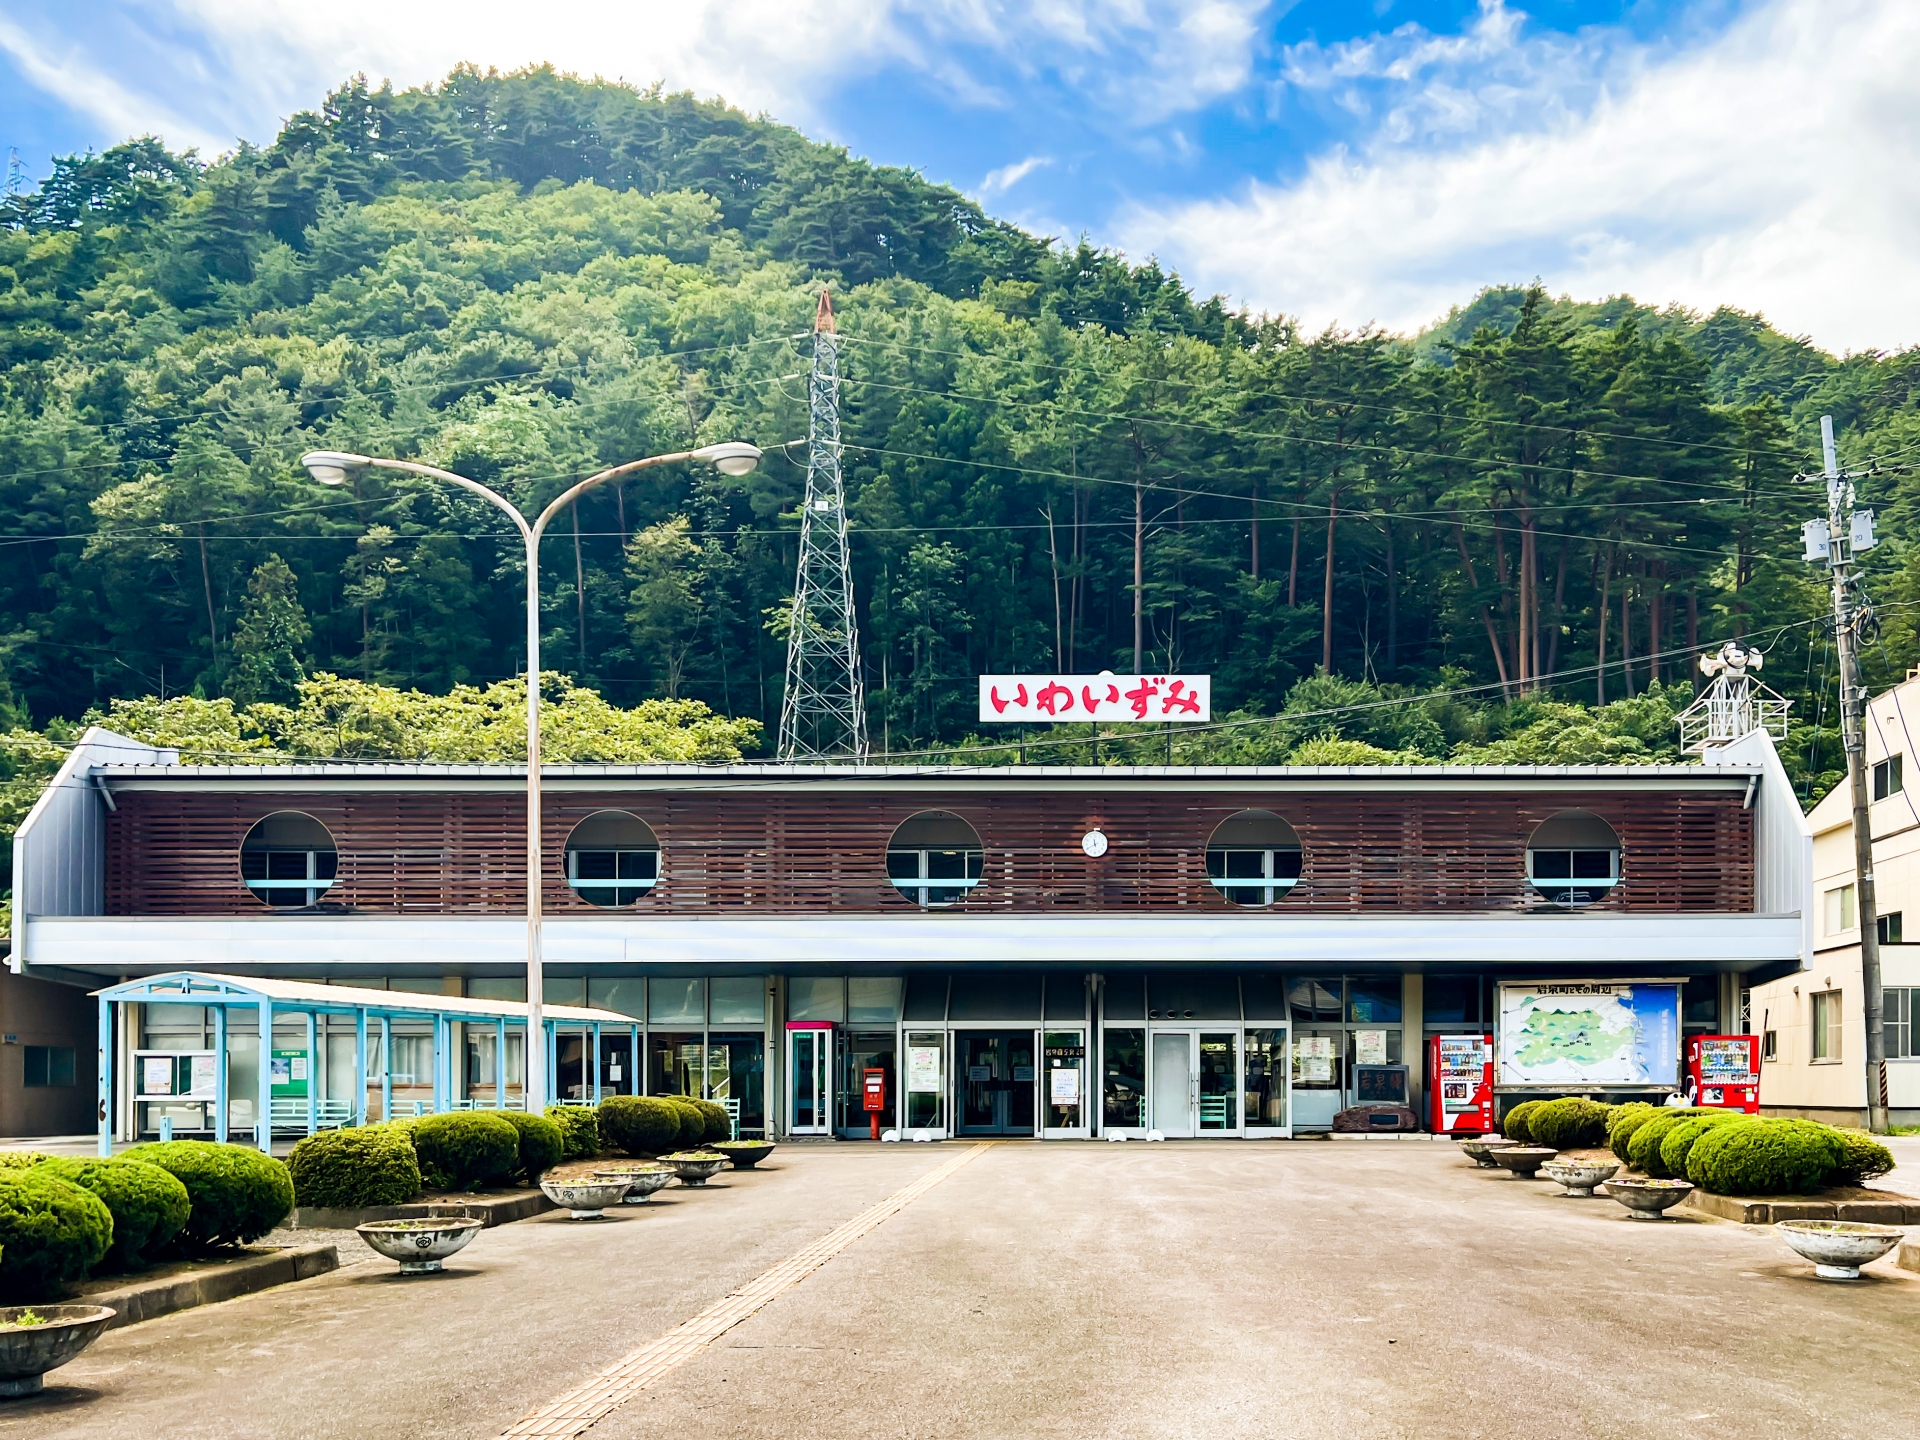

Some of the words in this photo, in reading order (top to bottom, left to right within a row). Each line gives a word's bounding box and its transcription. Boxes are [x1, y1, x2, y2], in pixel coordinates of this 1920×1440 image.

[1855, 534, 1863, 542] 20
[1818, 543, 1827, 551] 30
[990, 677, 1200, 720] いわいずみ
